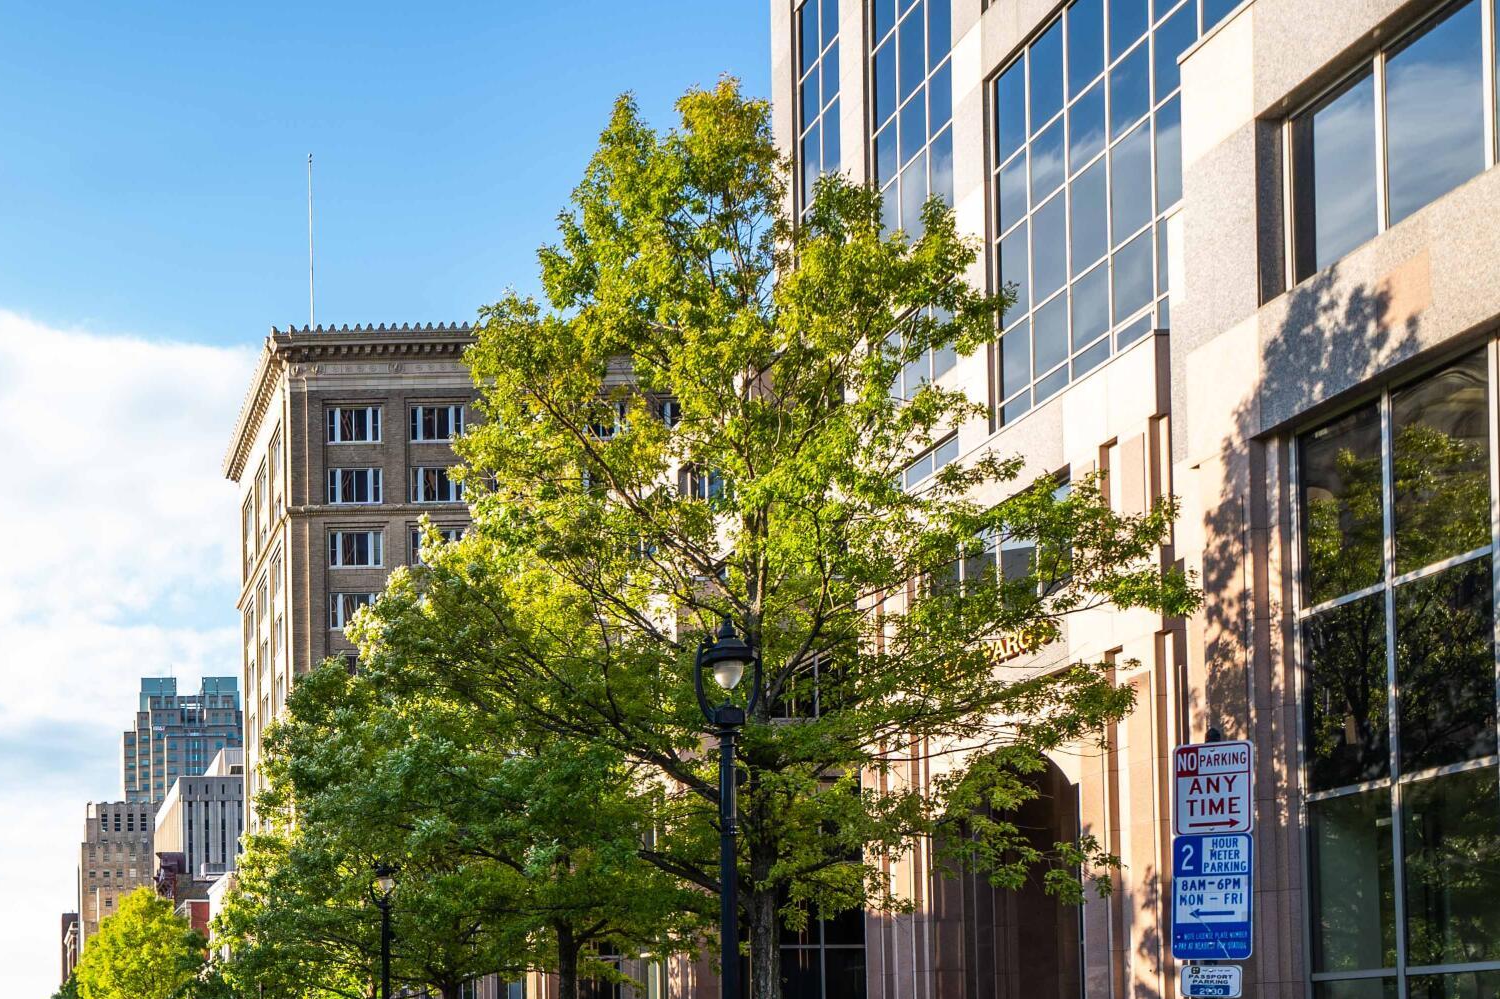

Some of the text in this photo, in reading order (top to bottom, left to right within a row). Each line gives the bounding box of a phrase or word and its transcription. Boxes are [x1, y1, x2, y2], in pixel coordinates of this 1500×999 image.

[1178, 752, 1246, 772] NO PARKING
[1189, 775, 1238, 795] ANY
[1186, 797, 1241, 817] TIME
[1212, 837, 1238, 849] HOUR
[1181, 844, 1194, 871] 2
[1210, 849, 1240, 860] METER
[1203, 861, 1246, 872] PARKING
[1179, 893, 1204, 906] MON
[1224, 893, 1243, 905] FRI
